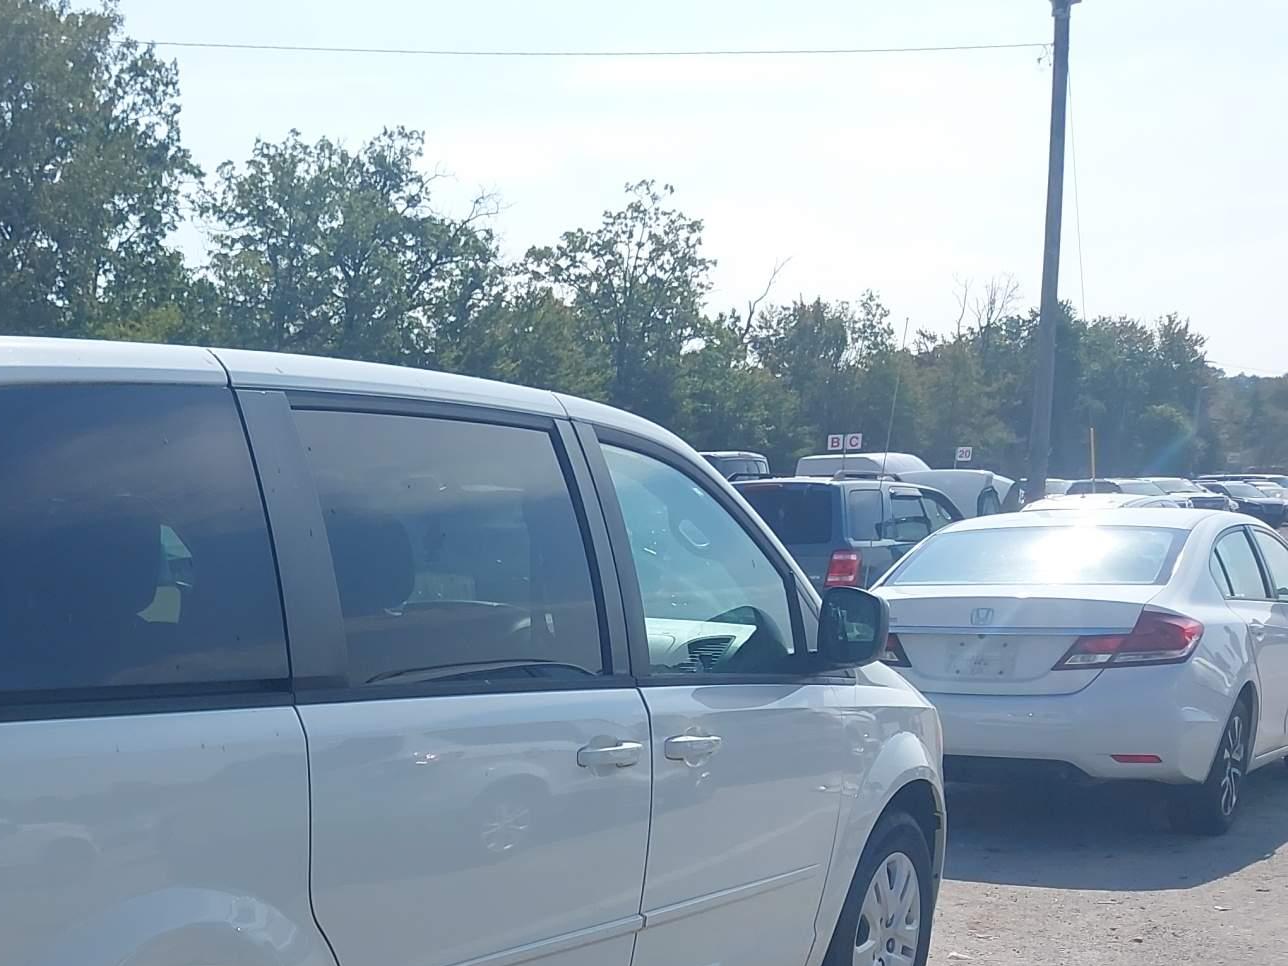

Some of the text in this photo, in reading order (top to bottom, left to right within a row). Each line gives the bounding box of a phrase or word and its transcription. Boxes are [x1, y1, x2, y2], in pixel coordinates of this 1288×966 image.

[831, 437, 840, 448] B
[849, 435, 859, 447] C
[958, 450, 970, 459] 20
